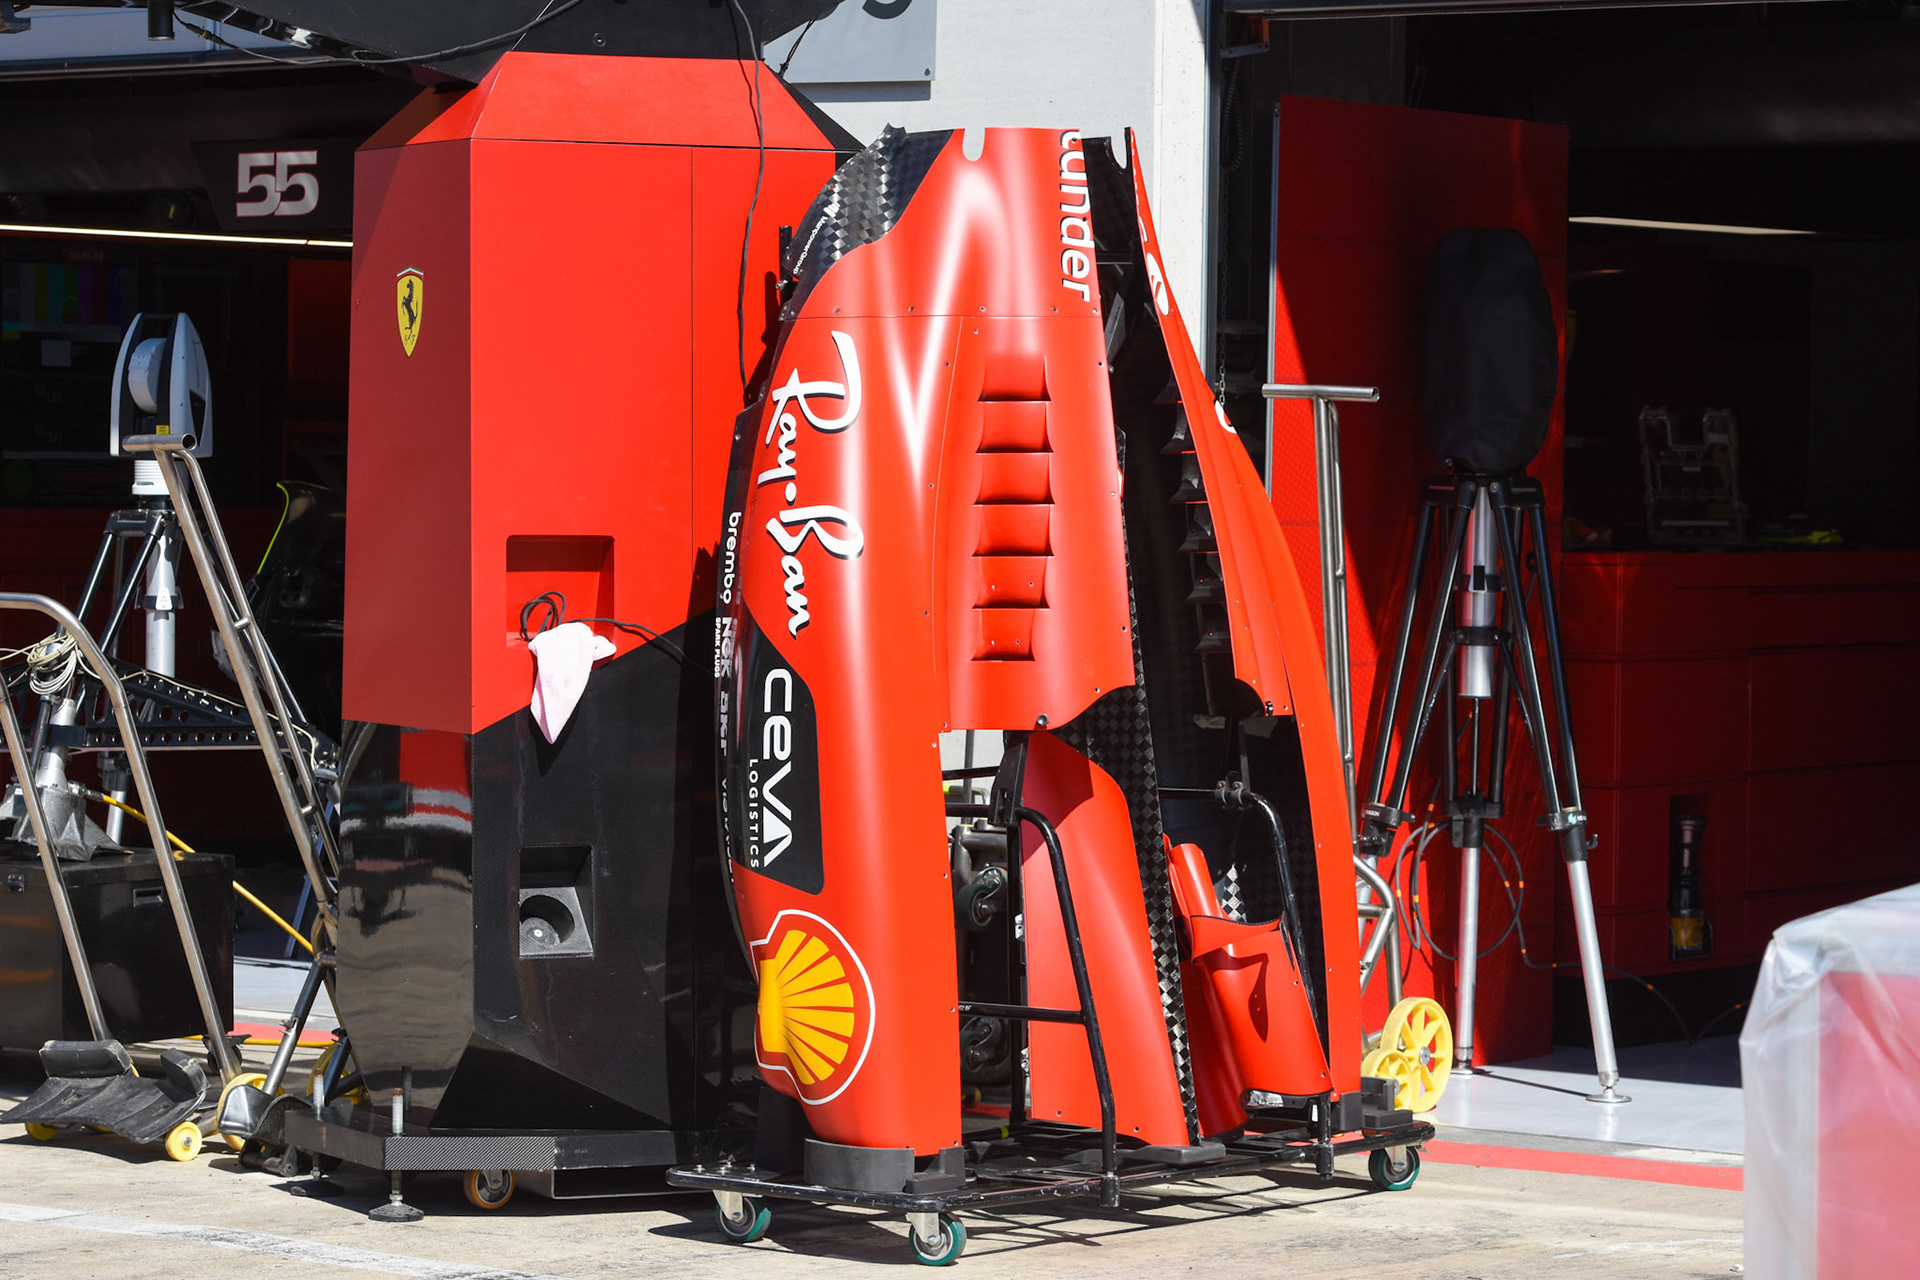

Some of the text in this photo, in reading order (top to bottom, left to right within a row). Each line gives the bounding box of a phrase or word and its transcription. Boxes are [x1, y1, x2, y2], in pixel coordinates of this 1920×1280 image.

[236, 149, 320, 217] 55
[793, 216, 829, 275] ManpowerGroup
[719, 511, 742, 605] brembo
[713, 648, 721, 678] PLUGS
[721, 617, 733, 679] NGK
[749, 758, 760, 868] LOGISTICS
